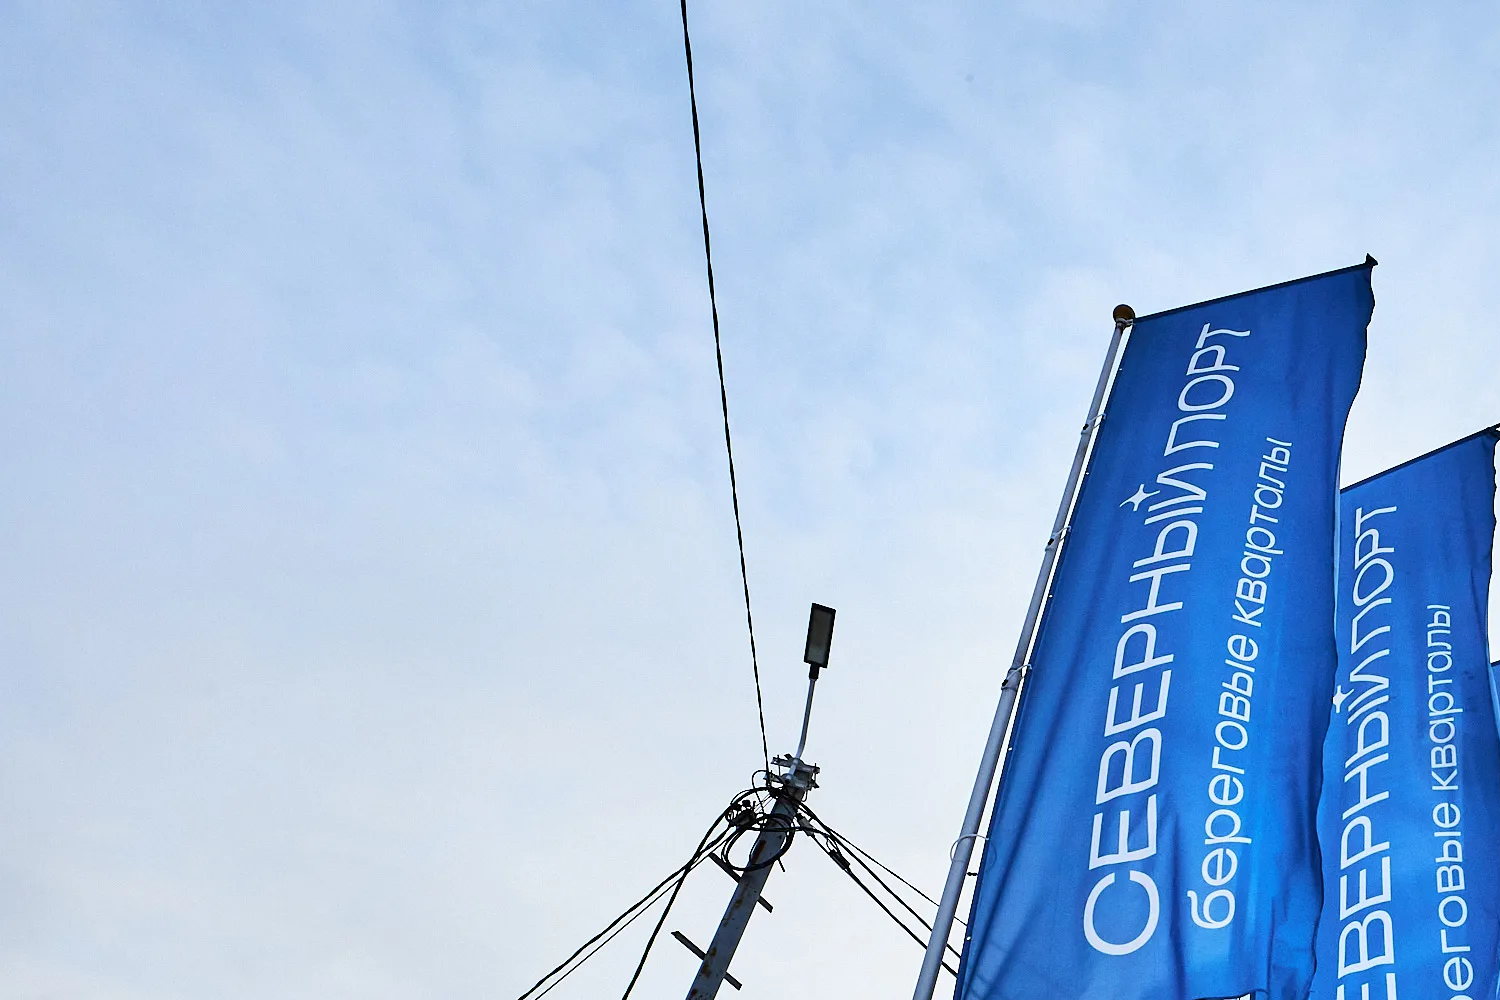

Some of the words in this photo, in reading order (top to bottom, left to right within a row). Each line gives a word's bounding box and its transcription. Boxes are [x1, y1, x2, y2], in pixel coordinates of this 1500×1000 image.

[1084, 462, 1213, 956] СЕВЕРНЫЙ
[1164, 323, 1251, 457] ПОРТ
[1187, 634, 1261, 929] береговые
[1232, 437, 1292, 627] кварталы
[1351, 506, 1397, 655] ПОРТ
[1427, 604, 1463, 791] кварталы
